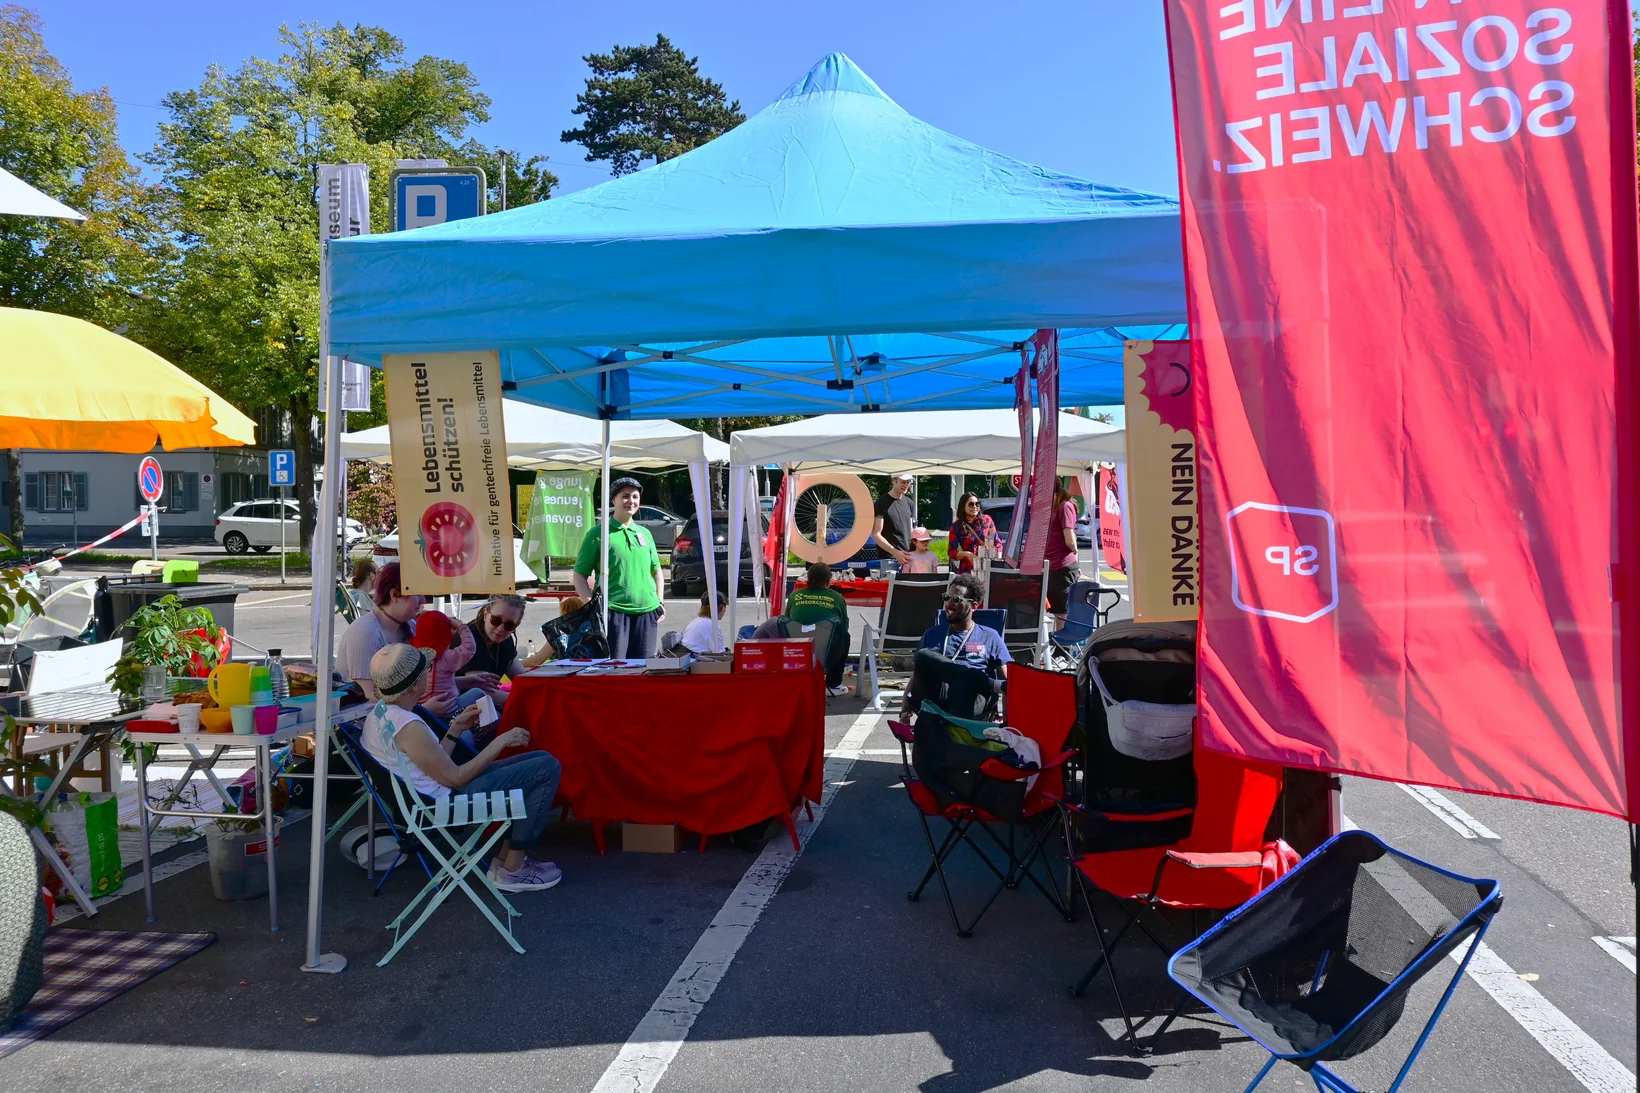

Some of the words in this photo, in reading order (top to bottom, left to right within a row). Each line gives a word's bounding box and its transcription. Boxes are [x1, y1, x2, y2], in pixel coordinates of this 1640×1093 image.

[405, 184, 447, 232] P
[411, 362, 441, 494] Lebensmittel
[472, 362, 490, 435] Lebensmittel
[276, 454, 288, 470] P
[437, 398, 464, 493] schützen!
[481, 438, 500, 507] gentechfreie
[1171, 443, 1194, 506] NEIN
[488, 510, 499, 526] für
[491, 529, 503, 576] Initiative
[1171, 515, 1195, 607] DANKE
